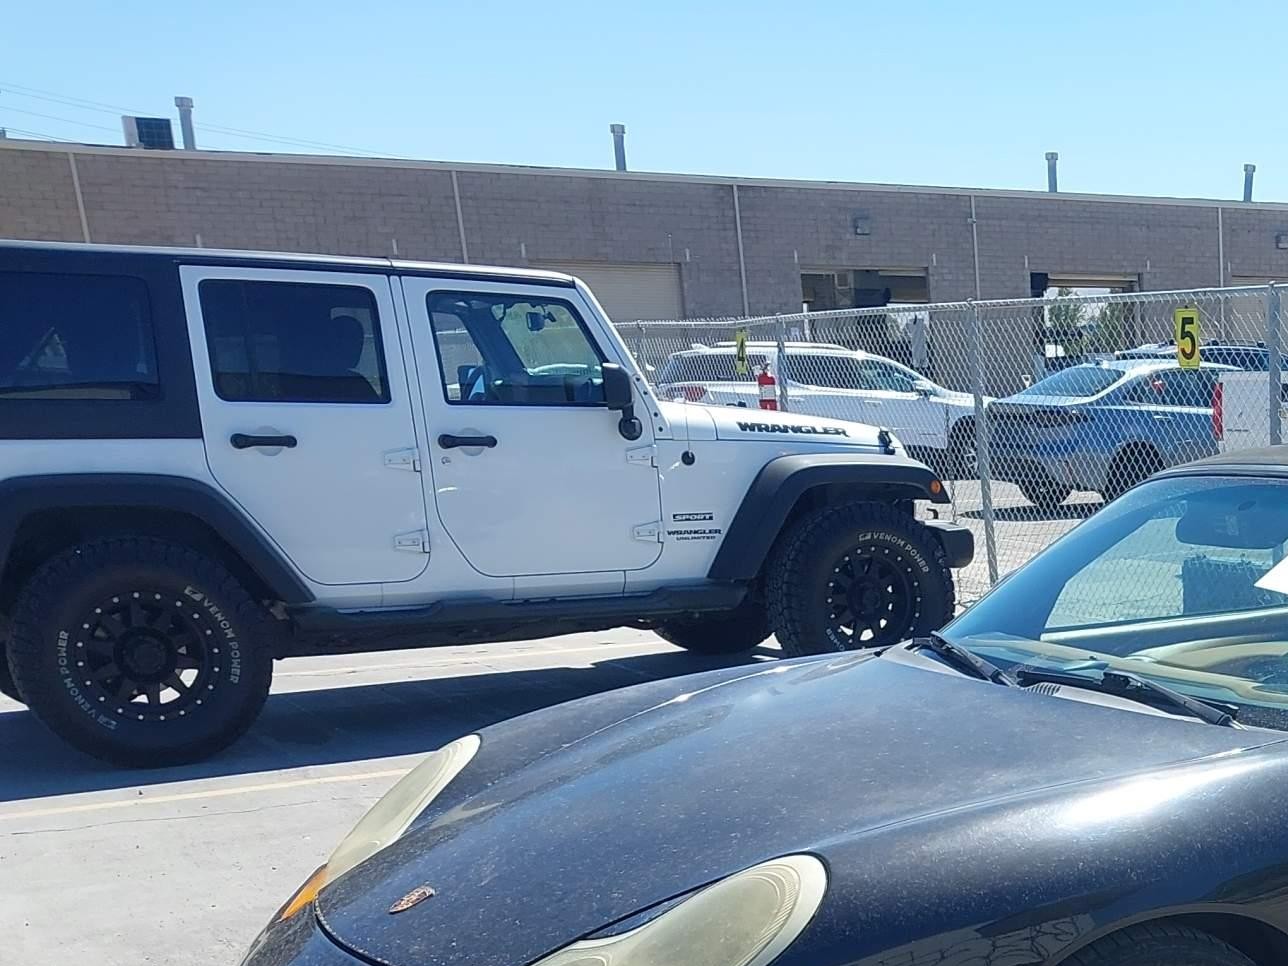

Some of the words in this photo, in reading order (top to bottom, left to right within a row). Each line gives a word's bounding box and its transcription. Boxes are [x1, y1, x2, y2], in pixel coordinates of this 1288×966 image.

[737, 338, 746, 367] 4
[1180, 316, 1196, 360] 5
[736, 421, 850, 438] WRANGLER
[674, 513, 713, 521] SPORT
[872, 532, 905, 547] VENOM
[904, 543, 930, 574] POWER
[57, 630, 70, 675] POWER
[203, 598, 236, 639] VENOM
[229, 641, 241, 684] POWER
[64, 677, 97, 718] VENOM
